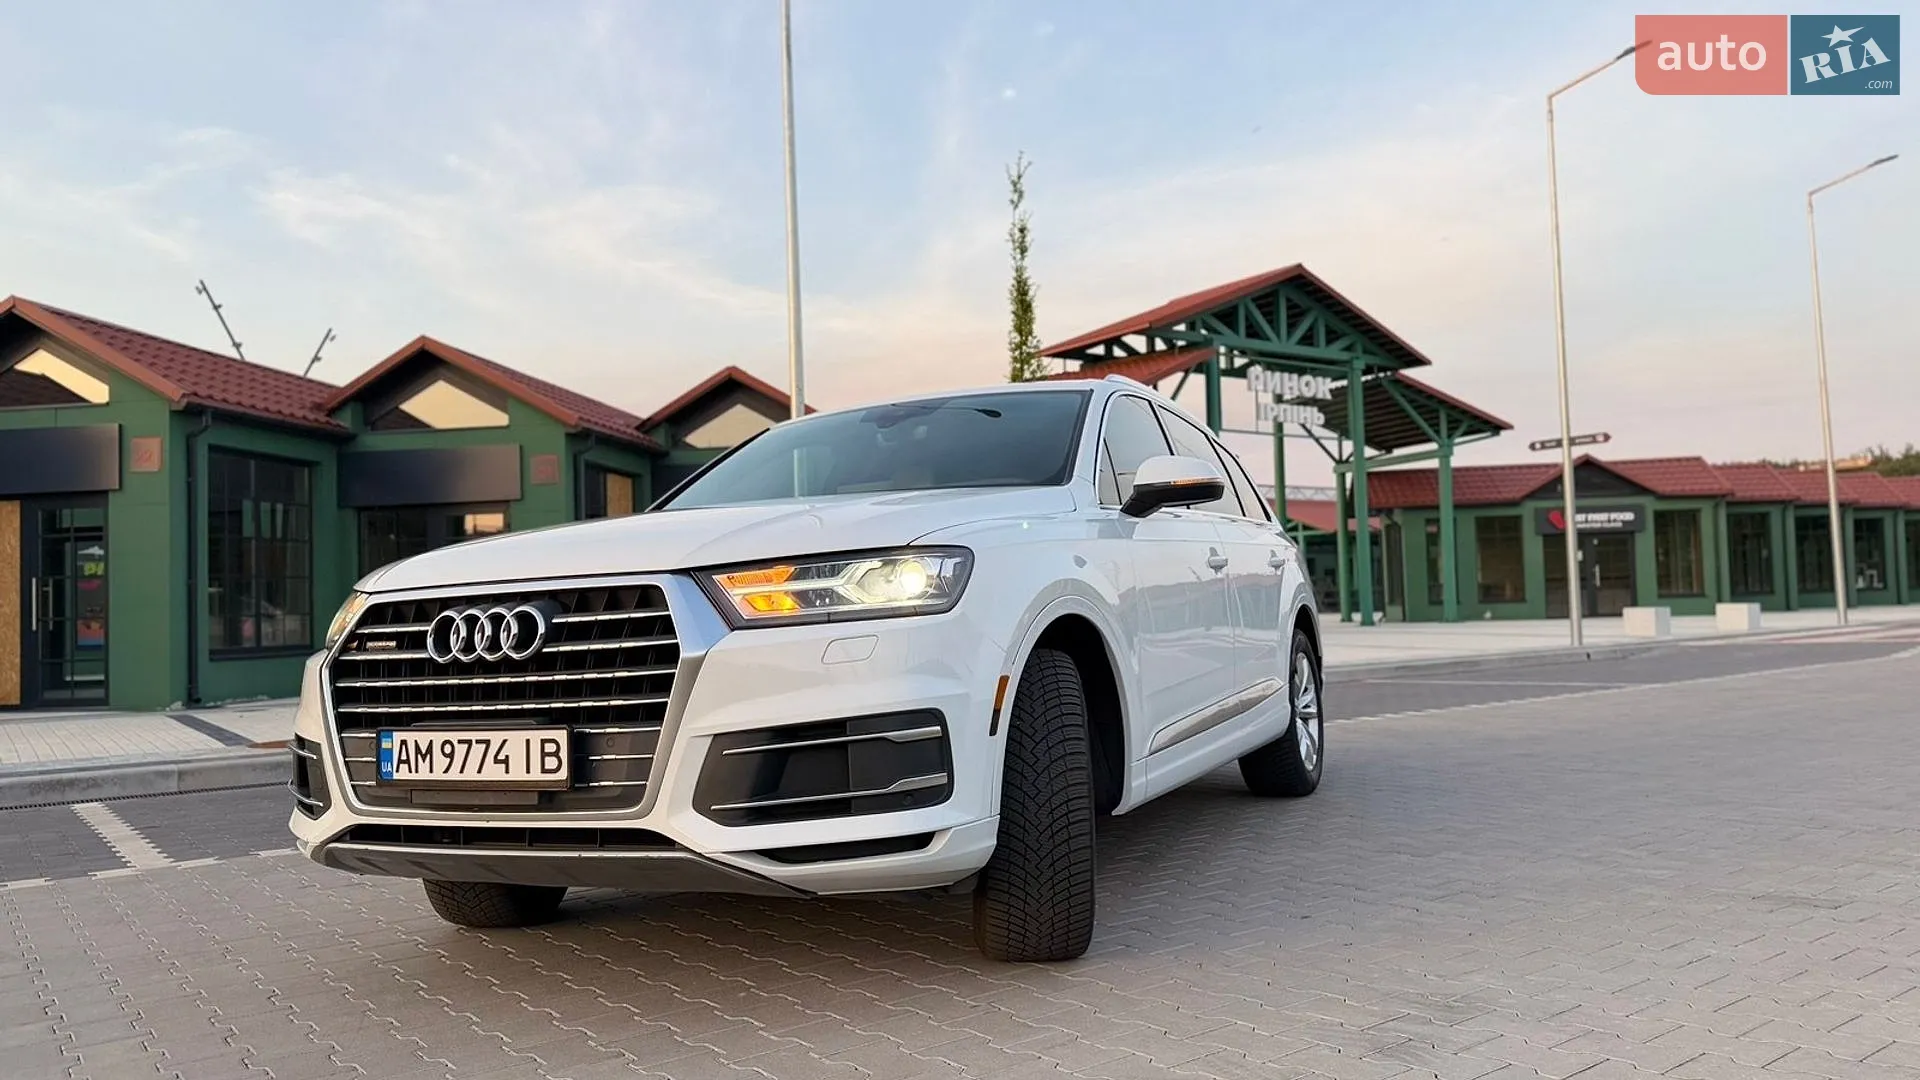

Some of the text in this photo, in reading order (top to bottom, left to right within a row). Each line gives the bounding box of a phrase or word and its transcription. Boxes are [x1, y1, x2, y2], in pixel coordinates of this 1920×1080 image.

[381, 761, 393, 773] UA
[395, 738, 563, 774] AM 9774 IB
